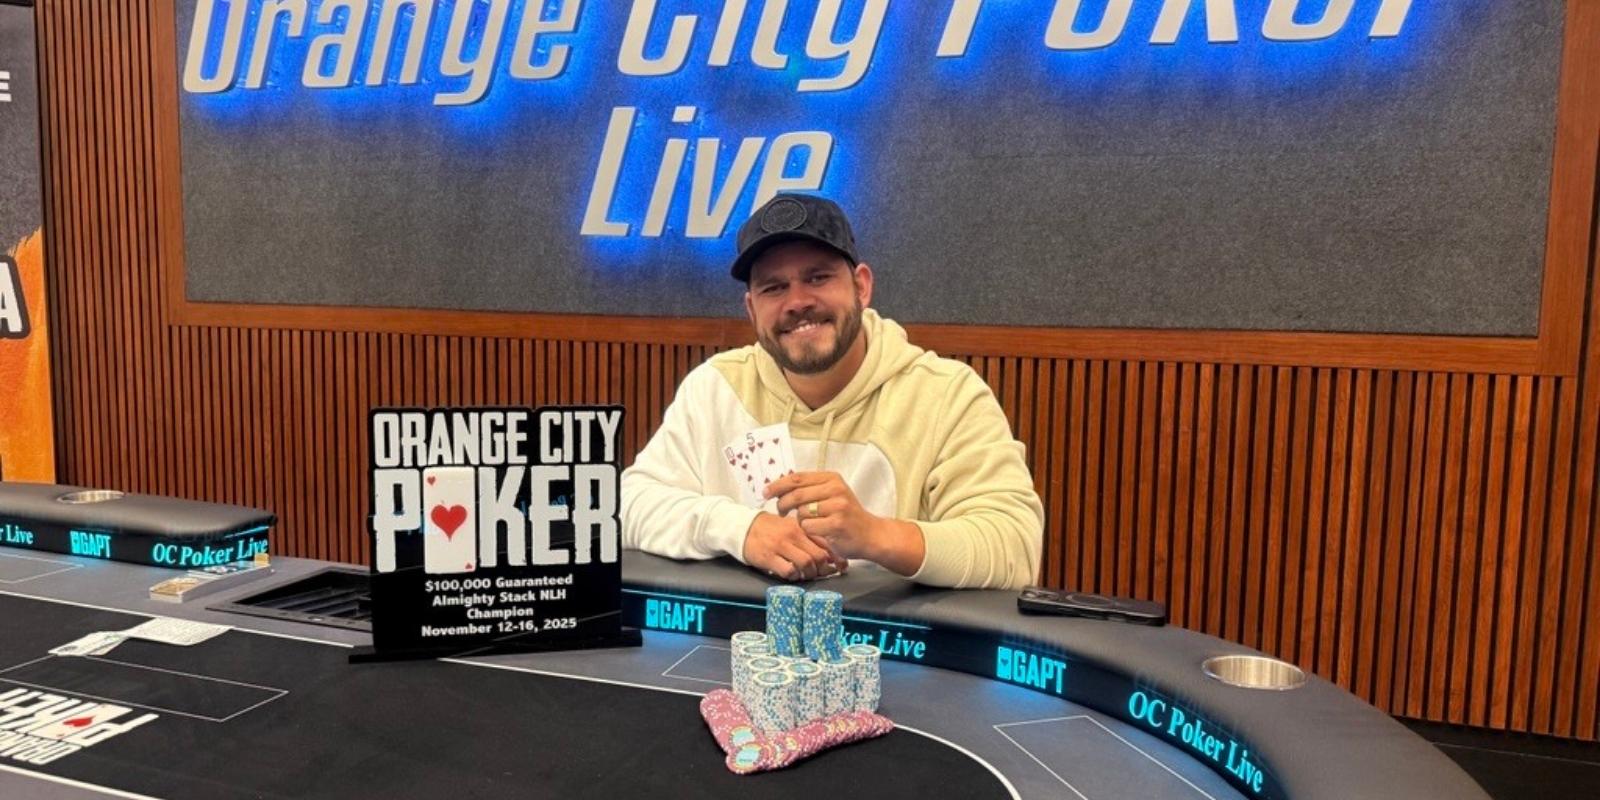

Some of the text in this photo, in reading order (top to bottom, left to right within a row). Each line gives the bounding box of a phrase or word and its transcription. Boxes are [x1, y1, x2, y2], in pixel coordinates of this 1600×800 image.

[183, 0, 581, 105] Orange
[581, 106, 834, 238] Live
[373, 410, 622, 467] ORANGE CITY
[6, 524, 34, 545] Live
[373, 464, 619, 574] PKER
[80, 532, 112, 558] GAPT
[152, 537, 269, 566] OC Poker Live
[425, 574, 573, 592] $100,000 Guaranteed
[432, 588, 566, 607] Almighty Stack NLH
[421, 617, 577, 636] November 12-16, 2025
[467, 606, 534, 619] Champion
[659, 601, 706, 633] GAPT
[838, 625, 926, 658] ker Live
[1012, 649, 1067, 694] GAPT
[1128, 691, 1264, 793] OC Poker Live
